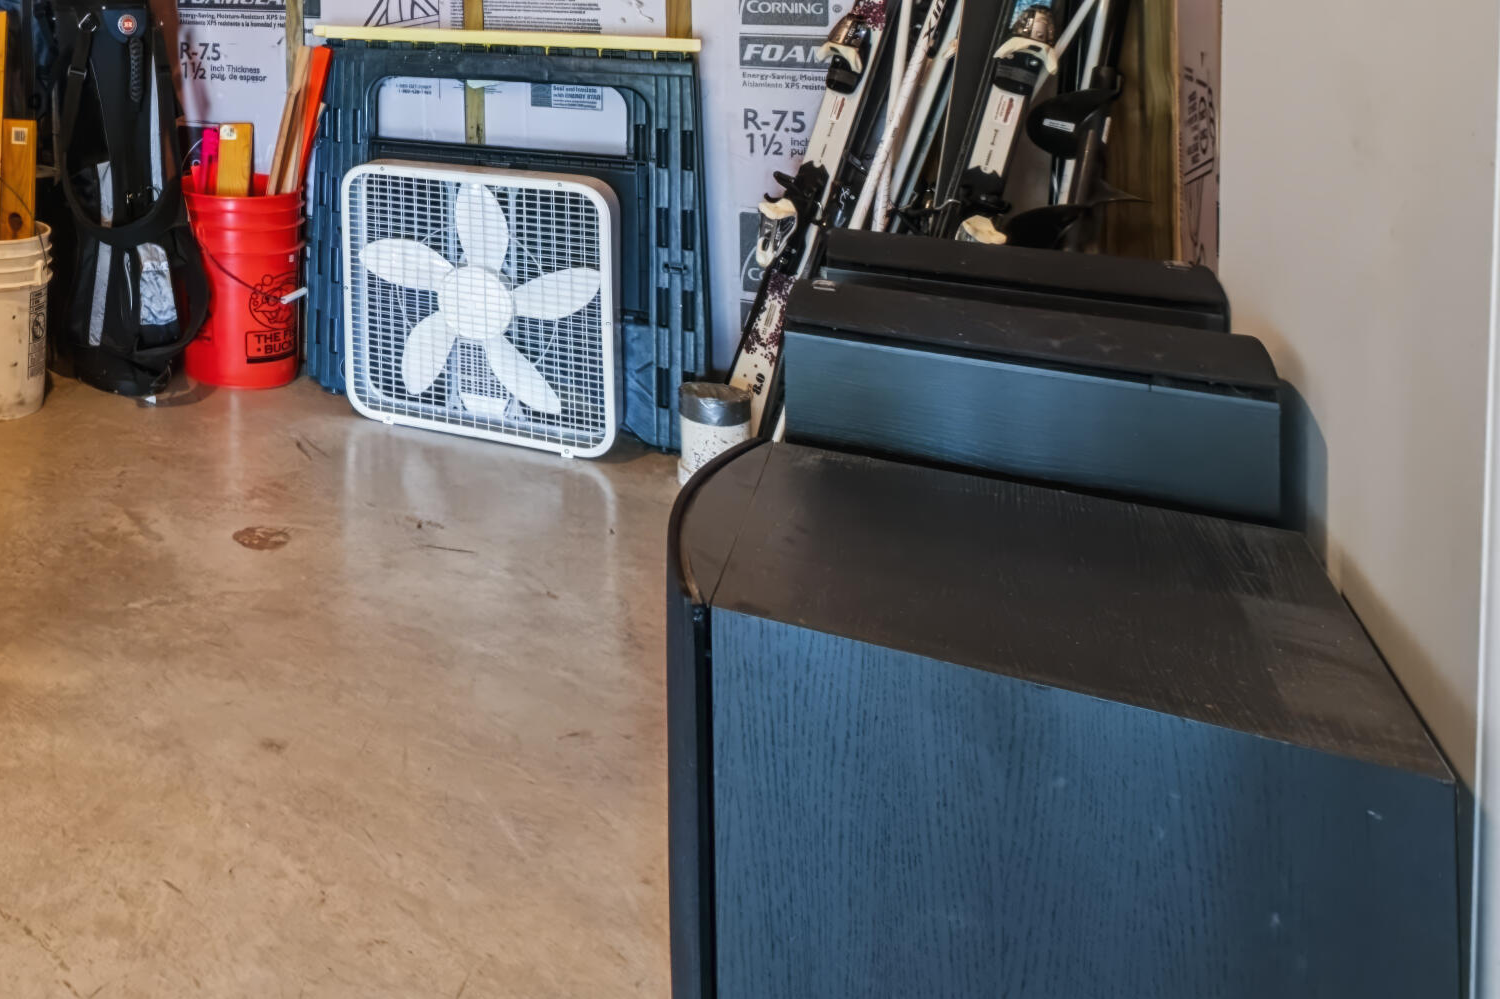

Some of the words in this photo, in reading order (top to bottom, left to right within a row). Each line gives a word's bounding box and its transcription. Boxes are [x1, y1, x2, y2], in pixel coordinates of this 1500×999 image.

[746, 0, 824, 15] CORNING
[179, 42, 221, 61] R-7.5
[210, 64, 225, 72] inch
[226, 64, 260, 74] Thickness
[238, 74, 267, 83] espesor
[743, 108, 806, 134] R-7.5
[254, 331, 281, 344] THE
[753, 372, 765, 396] 8.0
